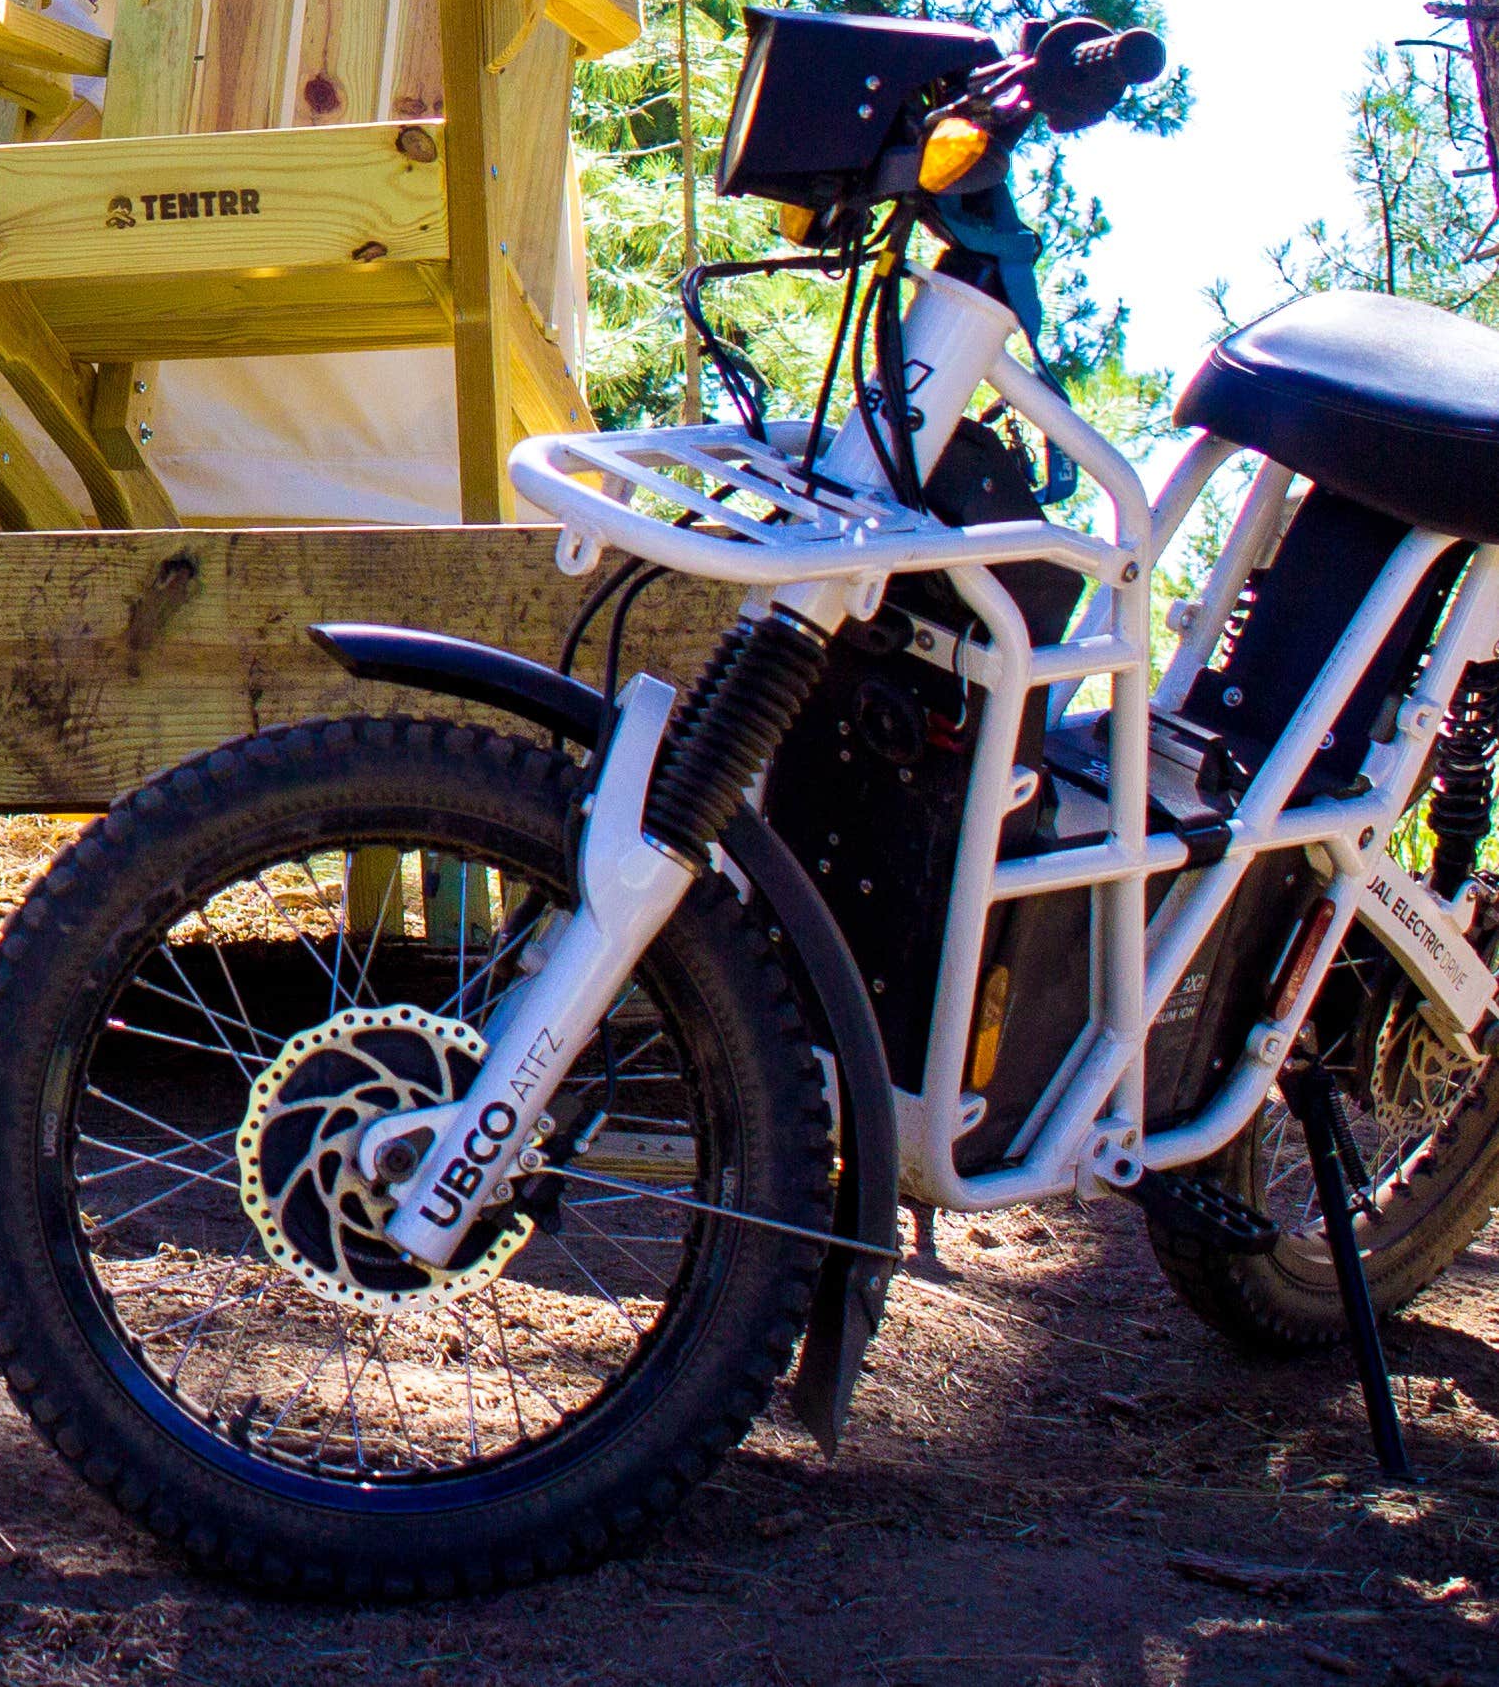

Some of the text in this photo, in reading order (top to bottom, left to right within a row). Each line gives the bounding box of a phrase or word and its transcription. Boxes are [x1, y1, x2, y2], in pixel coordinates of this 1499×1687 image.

[141, 189, 260, 221] TENTRR
[1390, 896, 1444, 961] ELECTRIC
[419, 1027, 564, 1228] UBCO ATFZ
